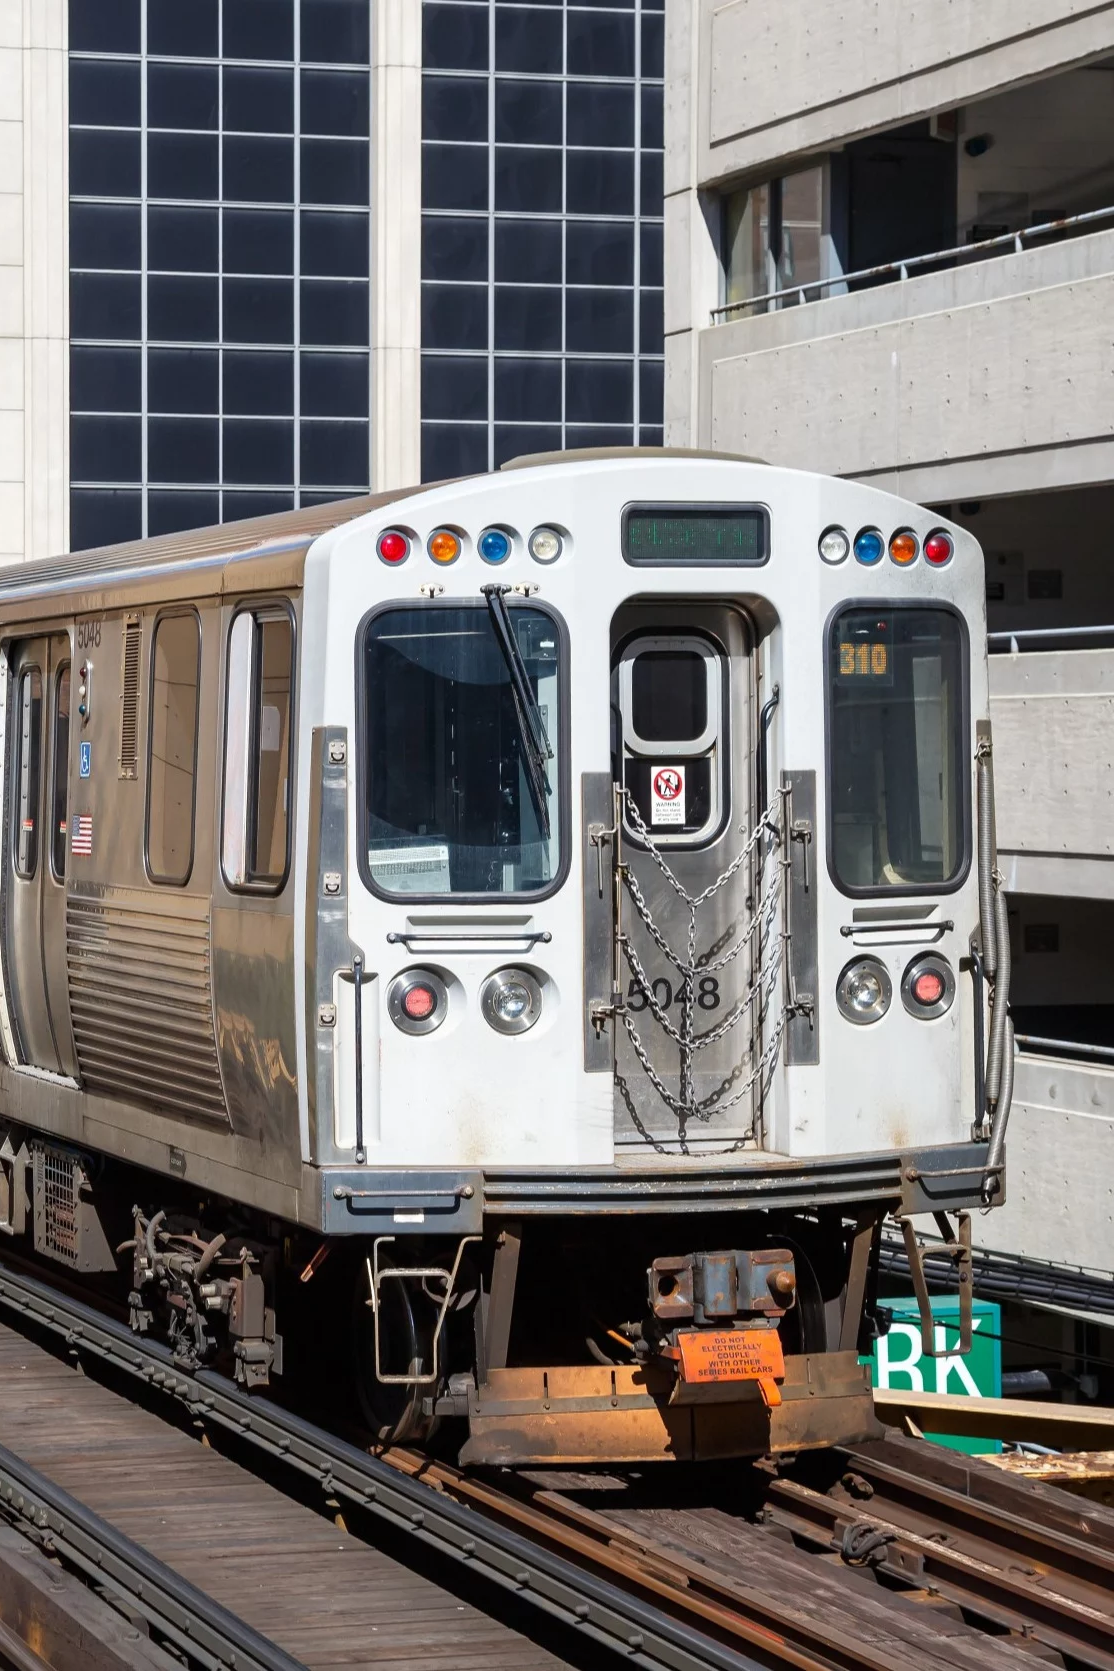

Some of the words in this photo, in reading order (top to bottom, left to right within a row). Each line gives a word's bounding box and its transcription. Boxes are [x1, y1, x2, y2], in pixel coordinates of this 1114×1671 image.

[78, 619, 101, 649] 5048
[839, 643, 887, 675] 310
[626, 976, 721, 1012] 5048
[702, 1344, 762, 1352] ELECTRICALLY
[877, 1318, 983, 1398] RK
[698, 1368, 728, 1376] SERIES
